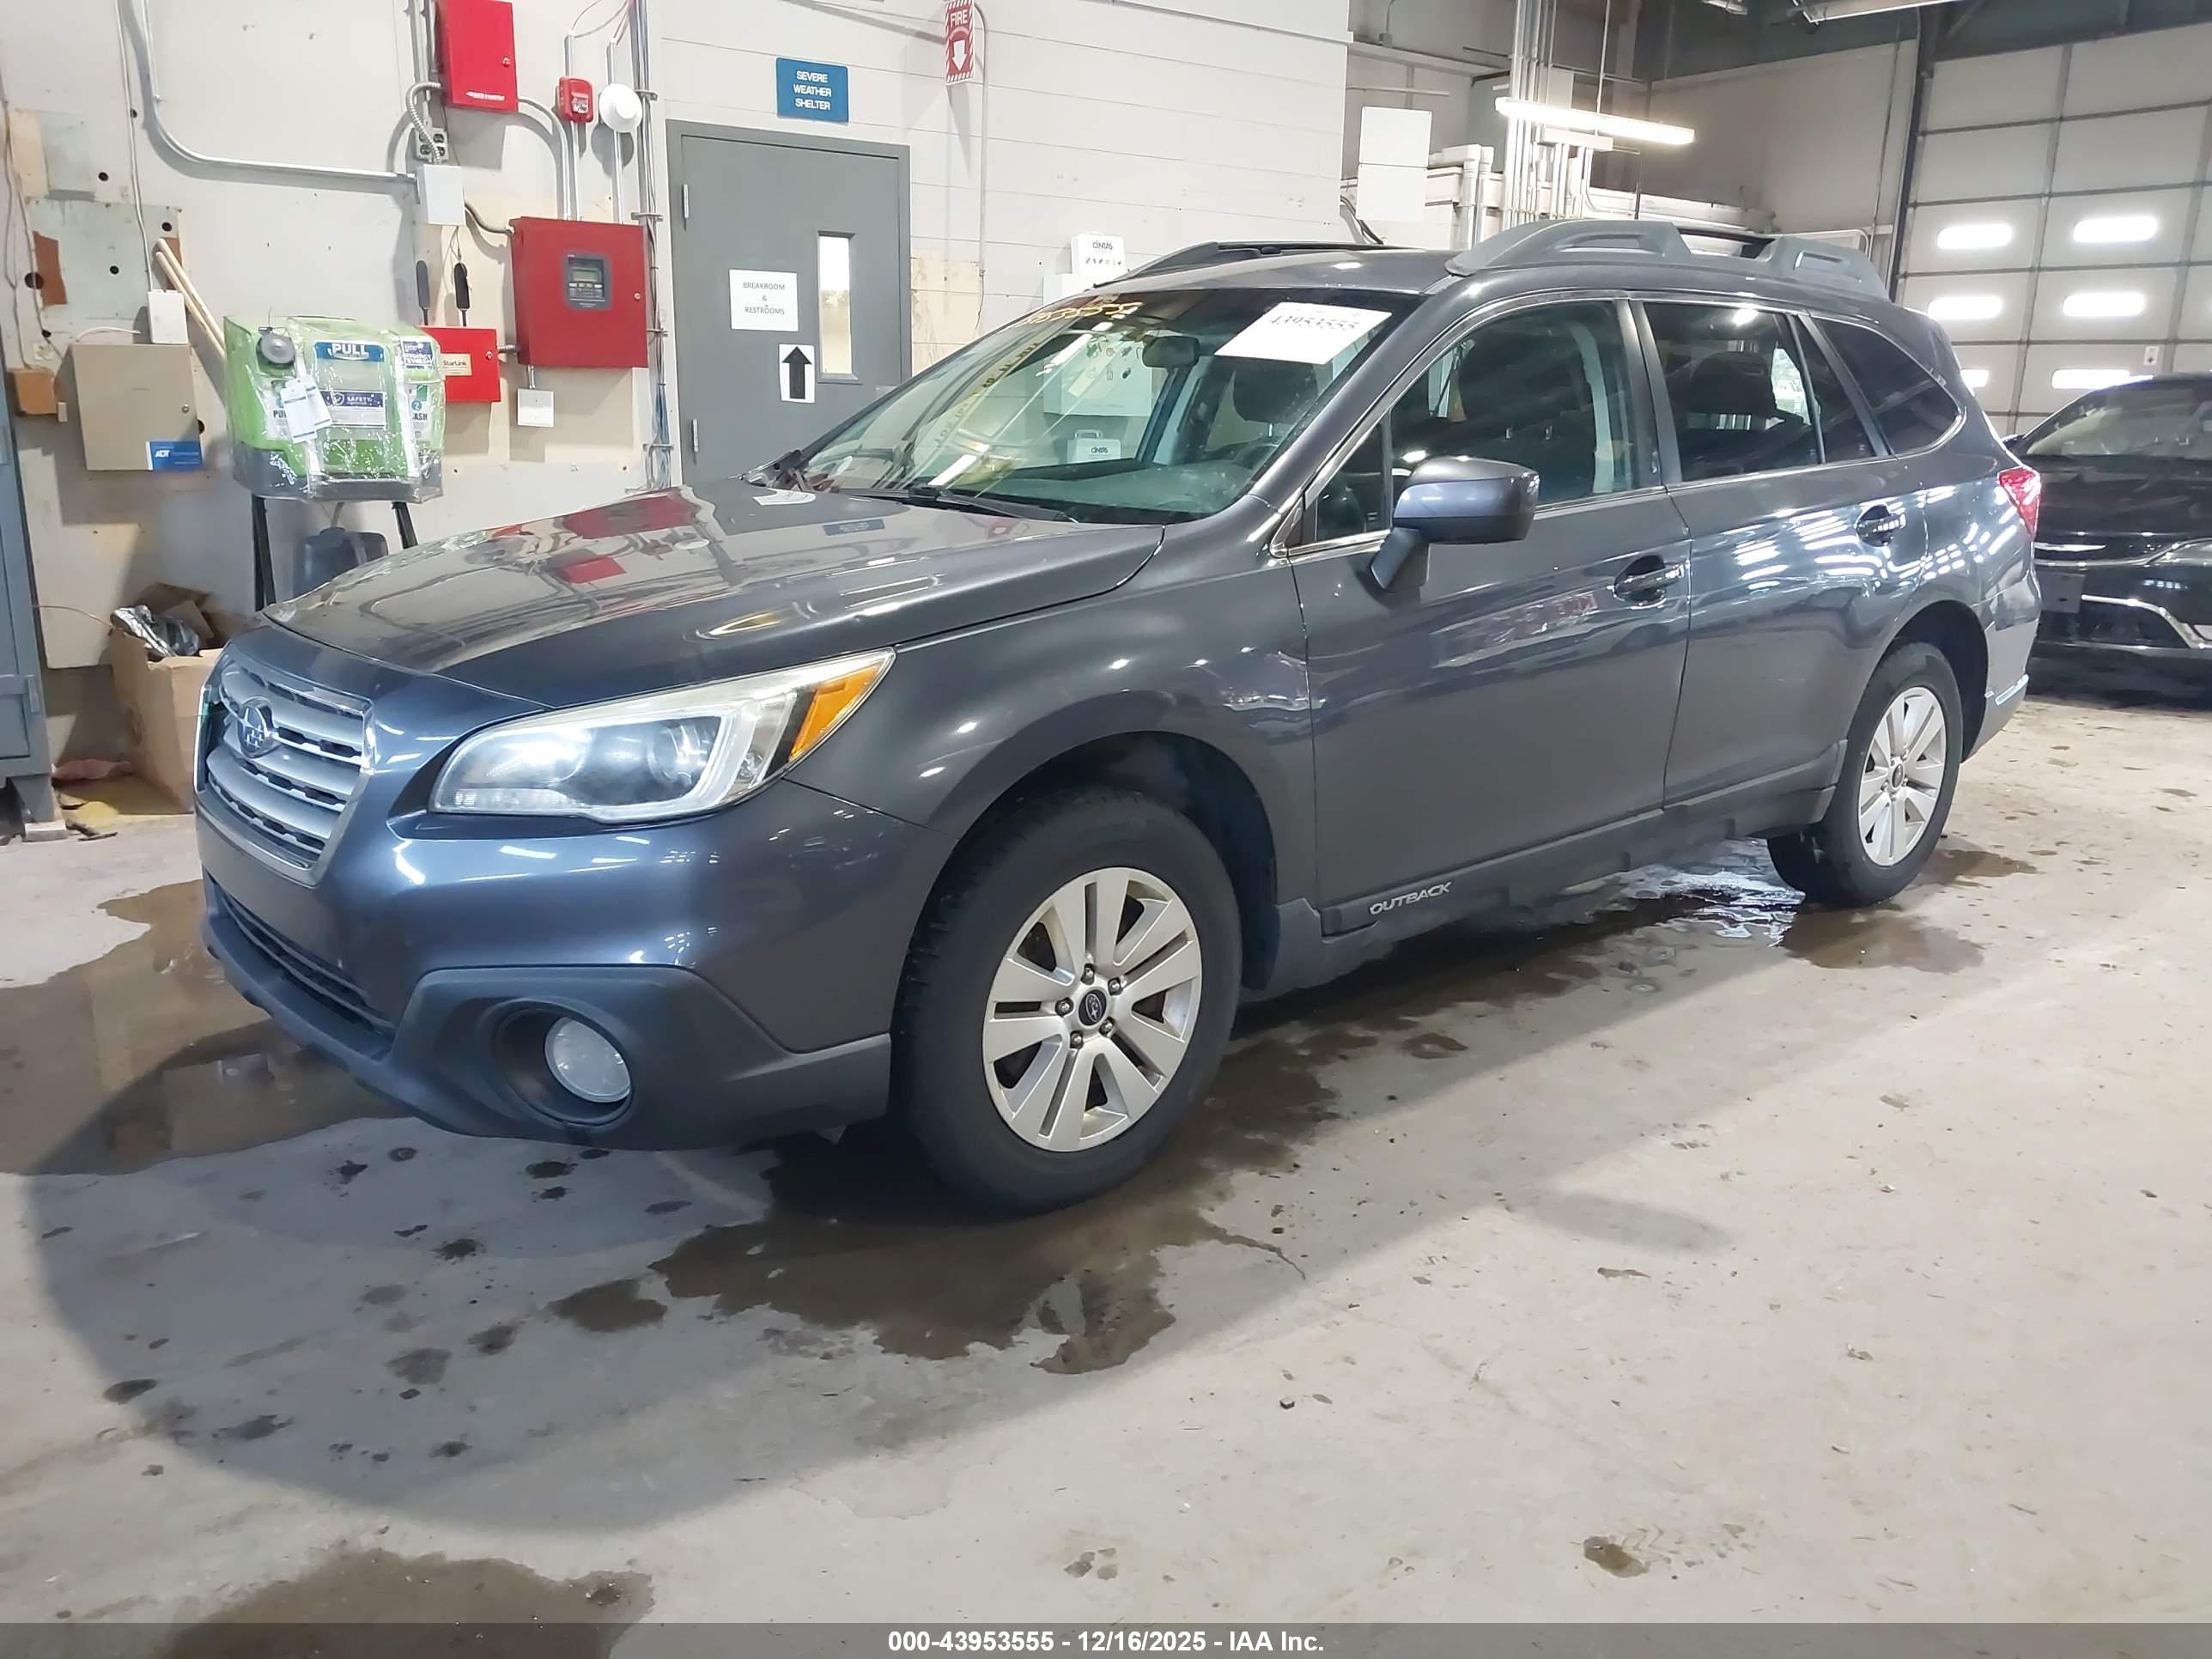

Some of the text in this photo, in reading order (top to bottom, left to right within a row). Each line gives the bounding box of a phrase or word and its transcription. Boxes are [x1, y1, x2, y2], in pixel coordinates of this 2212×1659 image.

[950, 9, 969, 27] FIRE
[796, 70, 828, 82] SEVERE
[793, 84, 831, 97] WEATHER
[795, 98, 830, 110] SHELTER
[743, 282, 786, 290] BREAKROOM
[744, 307, 786, 315] RESTROOMS
[331, 343, 369, 356] PULL
[1369, 881, 1452, 915] OUTBACK
